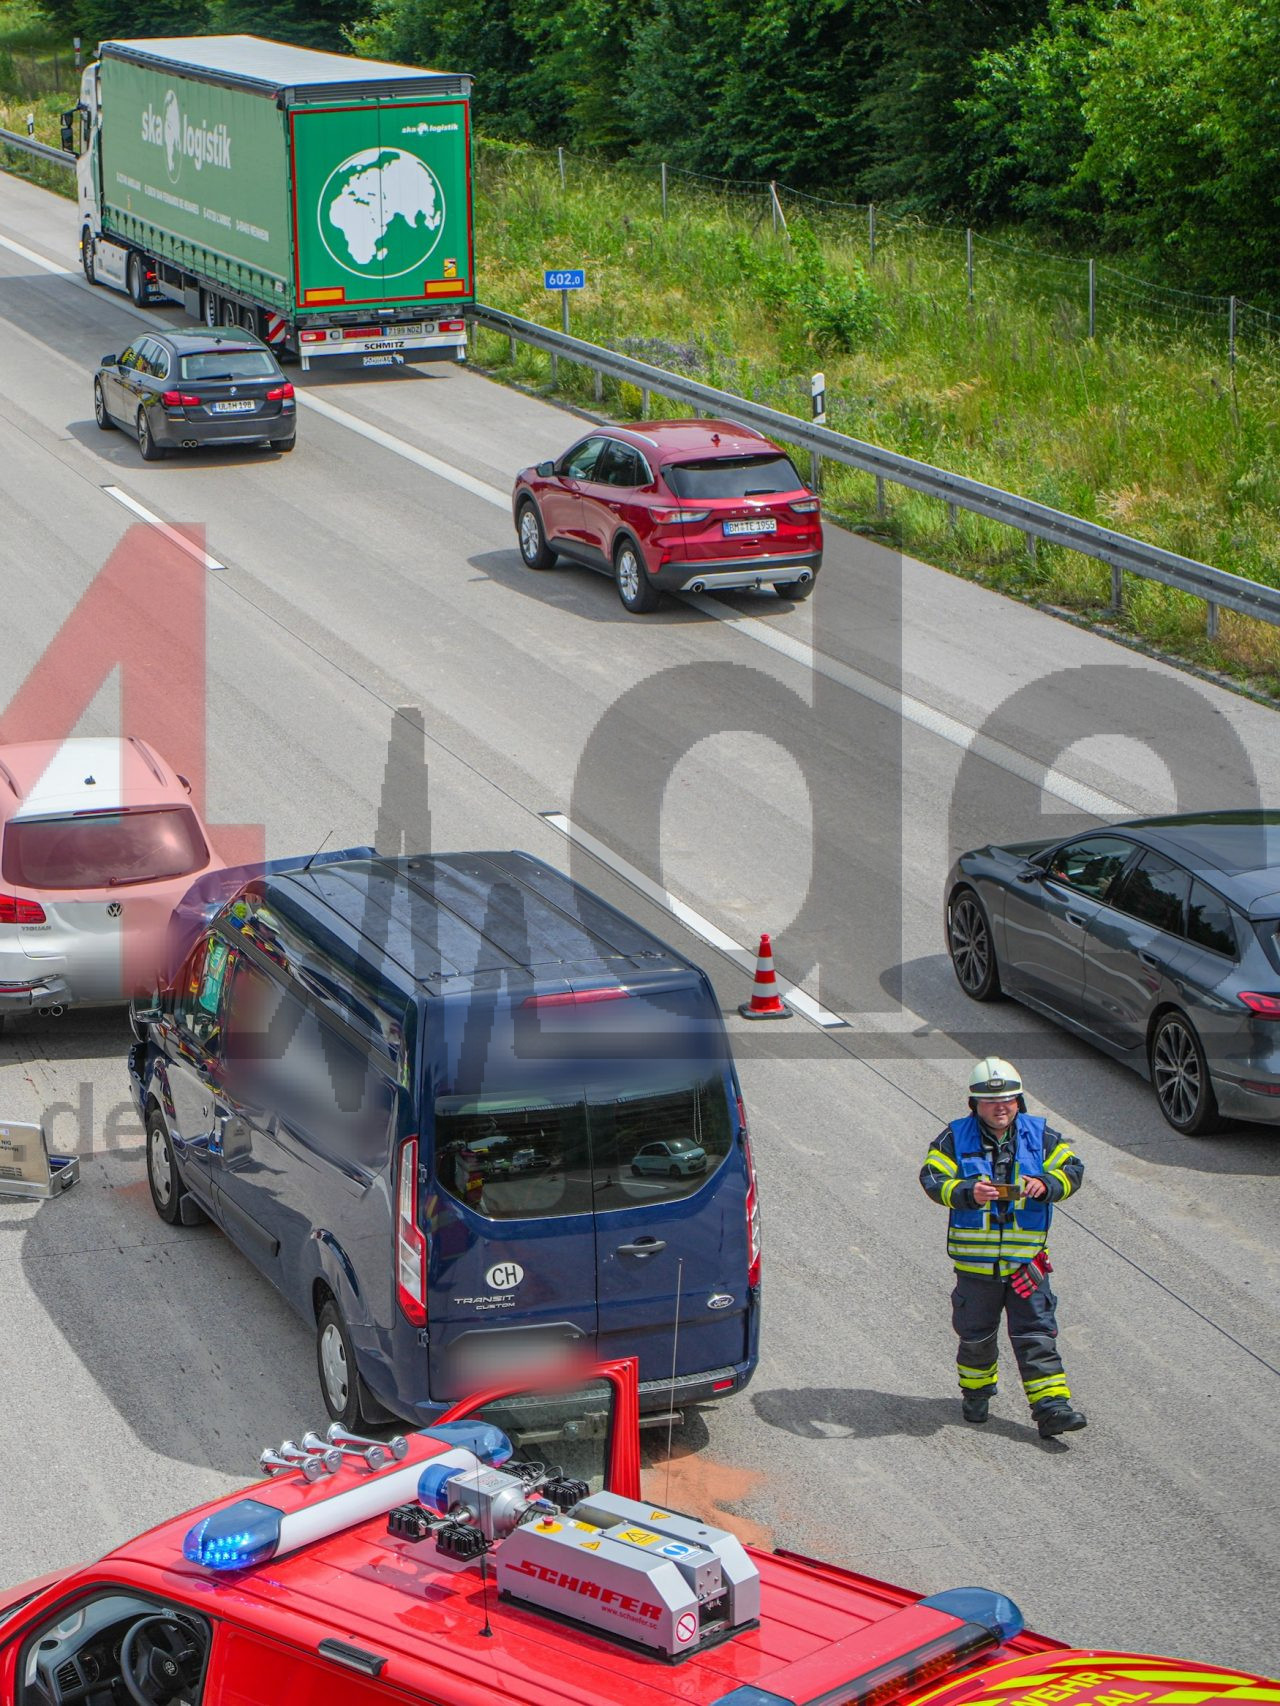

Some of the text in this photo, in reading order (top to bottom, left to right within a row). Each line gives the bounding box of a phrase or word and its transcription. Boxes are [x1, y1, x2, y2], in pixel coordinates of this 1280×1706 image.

[142, 103, 231, 170] ska logistik
[549, 273, 580, 285] 602.0
[364, 341, 405, 351] SCHMITZ
[492, 1265, 517, 1287] CH
[454, 1294, 515, 1304] TRANSIT
[476, 1302, 516, 1310] CUSTOM
[505, 1560, 663, 1621] SCHÄFER
